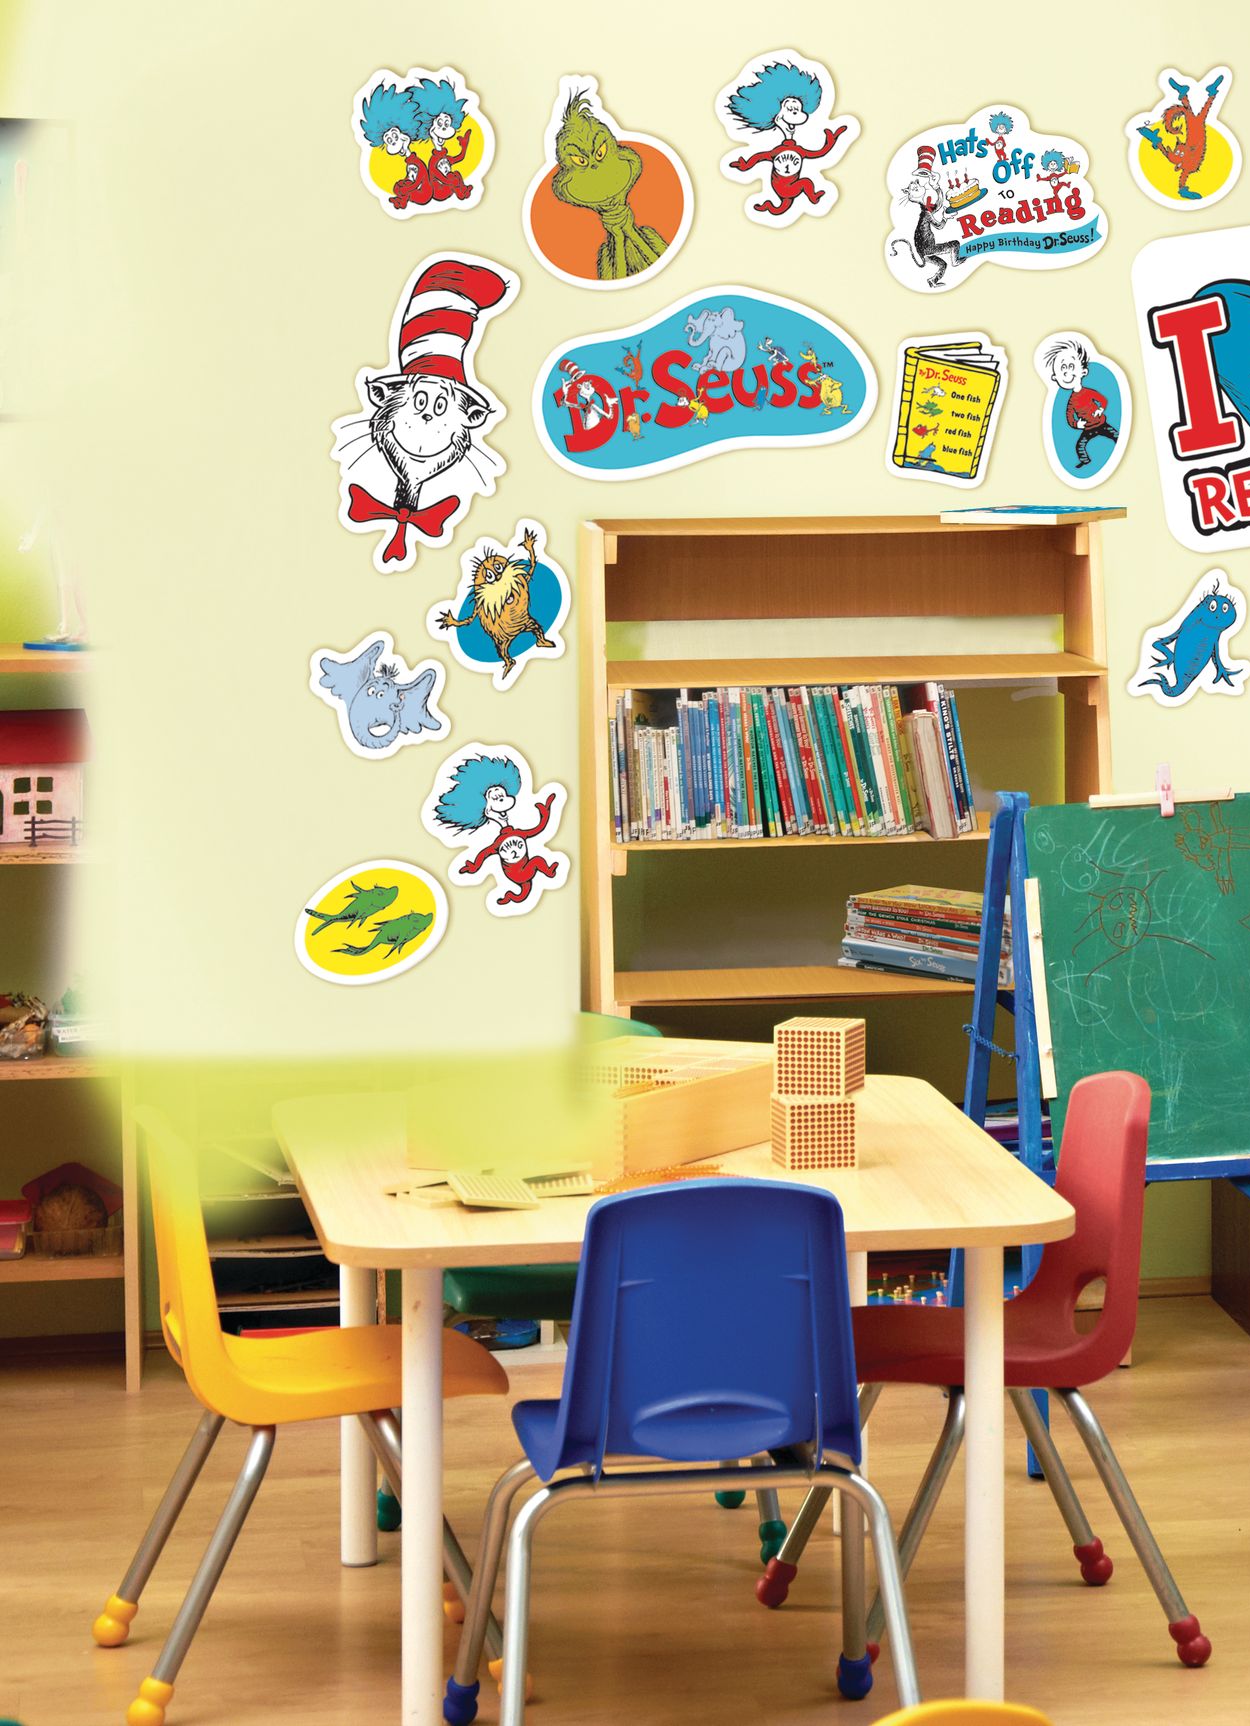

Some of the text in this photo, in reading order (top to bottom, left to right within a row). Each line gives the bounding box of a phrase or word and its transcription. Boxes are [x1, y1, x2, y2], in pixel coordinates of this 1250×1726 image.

[937, 128, 989, 166] Hats
[775, 153, 800, 166] THING
[992, 148, 1036, 184] Off
[784, 165, 790, 174] 1
[998, 189, 1015, 200] TO
[956, 187, 1086, 240] Reading
[965, 239, 995, 254] Happy
[998, 237, 1041, 249] Birthday
[925, 367, 941, 380] Dr.
[941, 369, 968, 386] Seuss
[1149, 294, 1242, 460] I
[651, 349, 826, 429] Seuss
[951, 391, 981, 404] One fish
[951, 410, 981, 422] two fish
[945, 427, 972, 438] red fish
[942, 445, 973, 457] blue fish
[940, 700, 955, 760] KING'S STILTS
[500, 839, 524, 853] THING
[510, 850, 520, 859] 2
